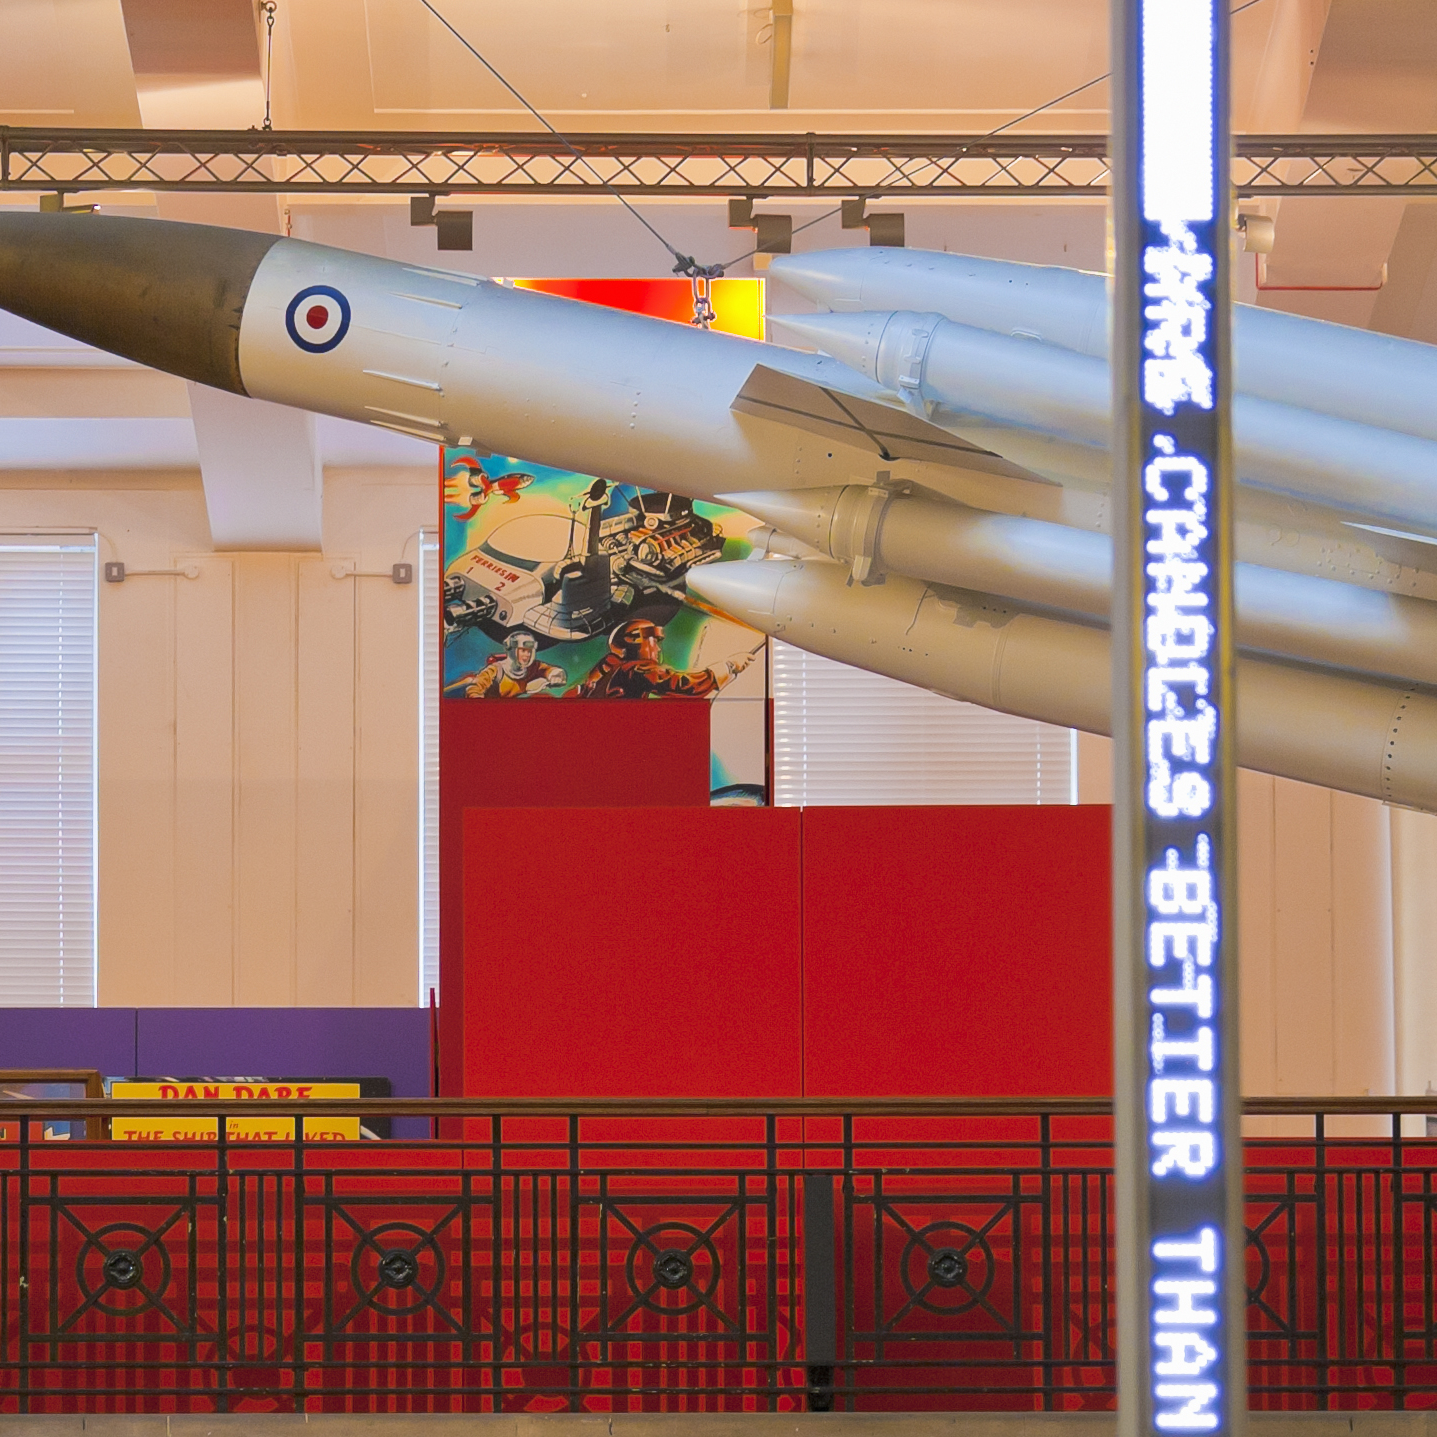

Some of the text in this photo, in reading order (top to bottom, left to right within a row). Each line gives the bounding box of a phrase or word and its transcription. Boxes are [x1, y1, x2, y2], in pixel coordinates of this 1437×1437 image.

[494, 582, 506, 592] 2
[1147, 456, 1214, 816] CANDLES
[1150, 868, 1215, 1176] BETTER
[158, 1085, 313, 1099] DAN DARE
[229, 1121, 239, 1129] in
[124, 1131, 164, 1141] THE
[1154, 1229, 1216, 1427] THAN
